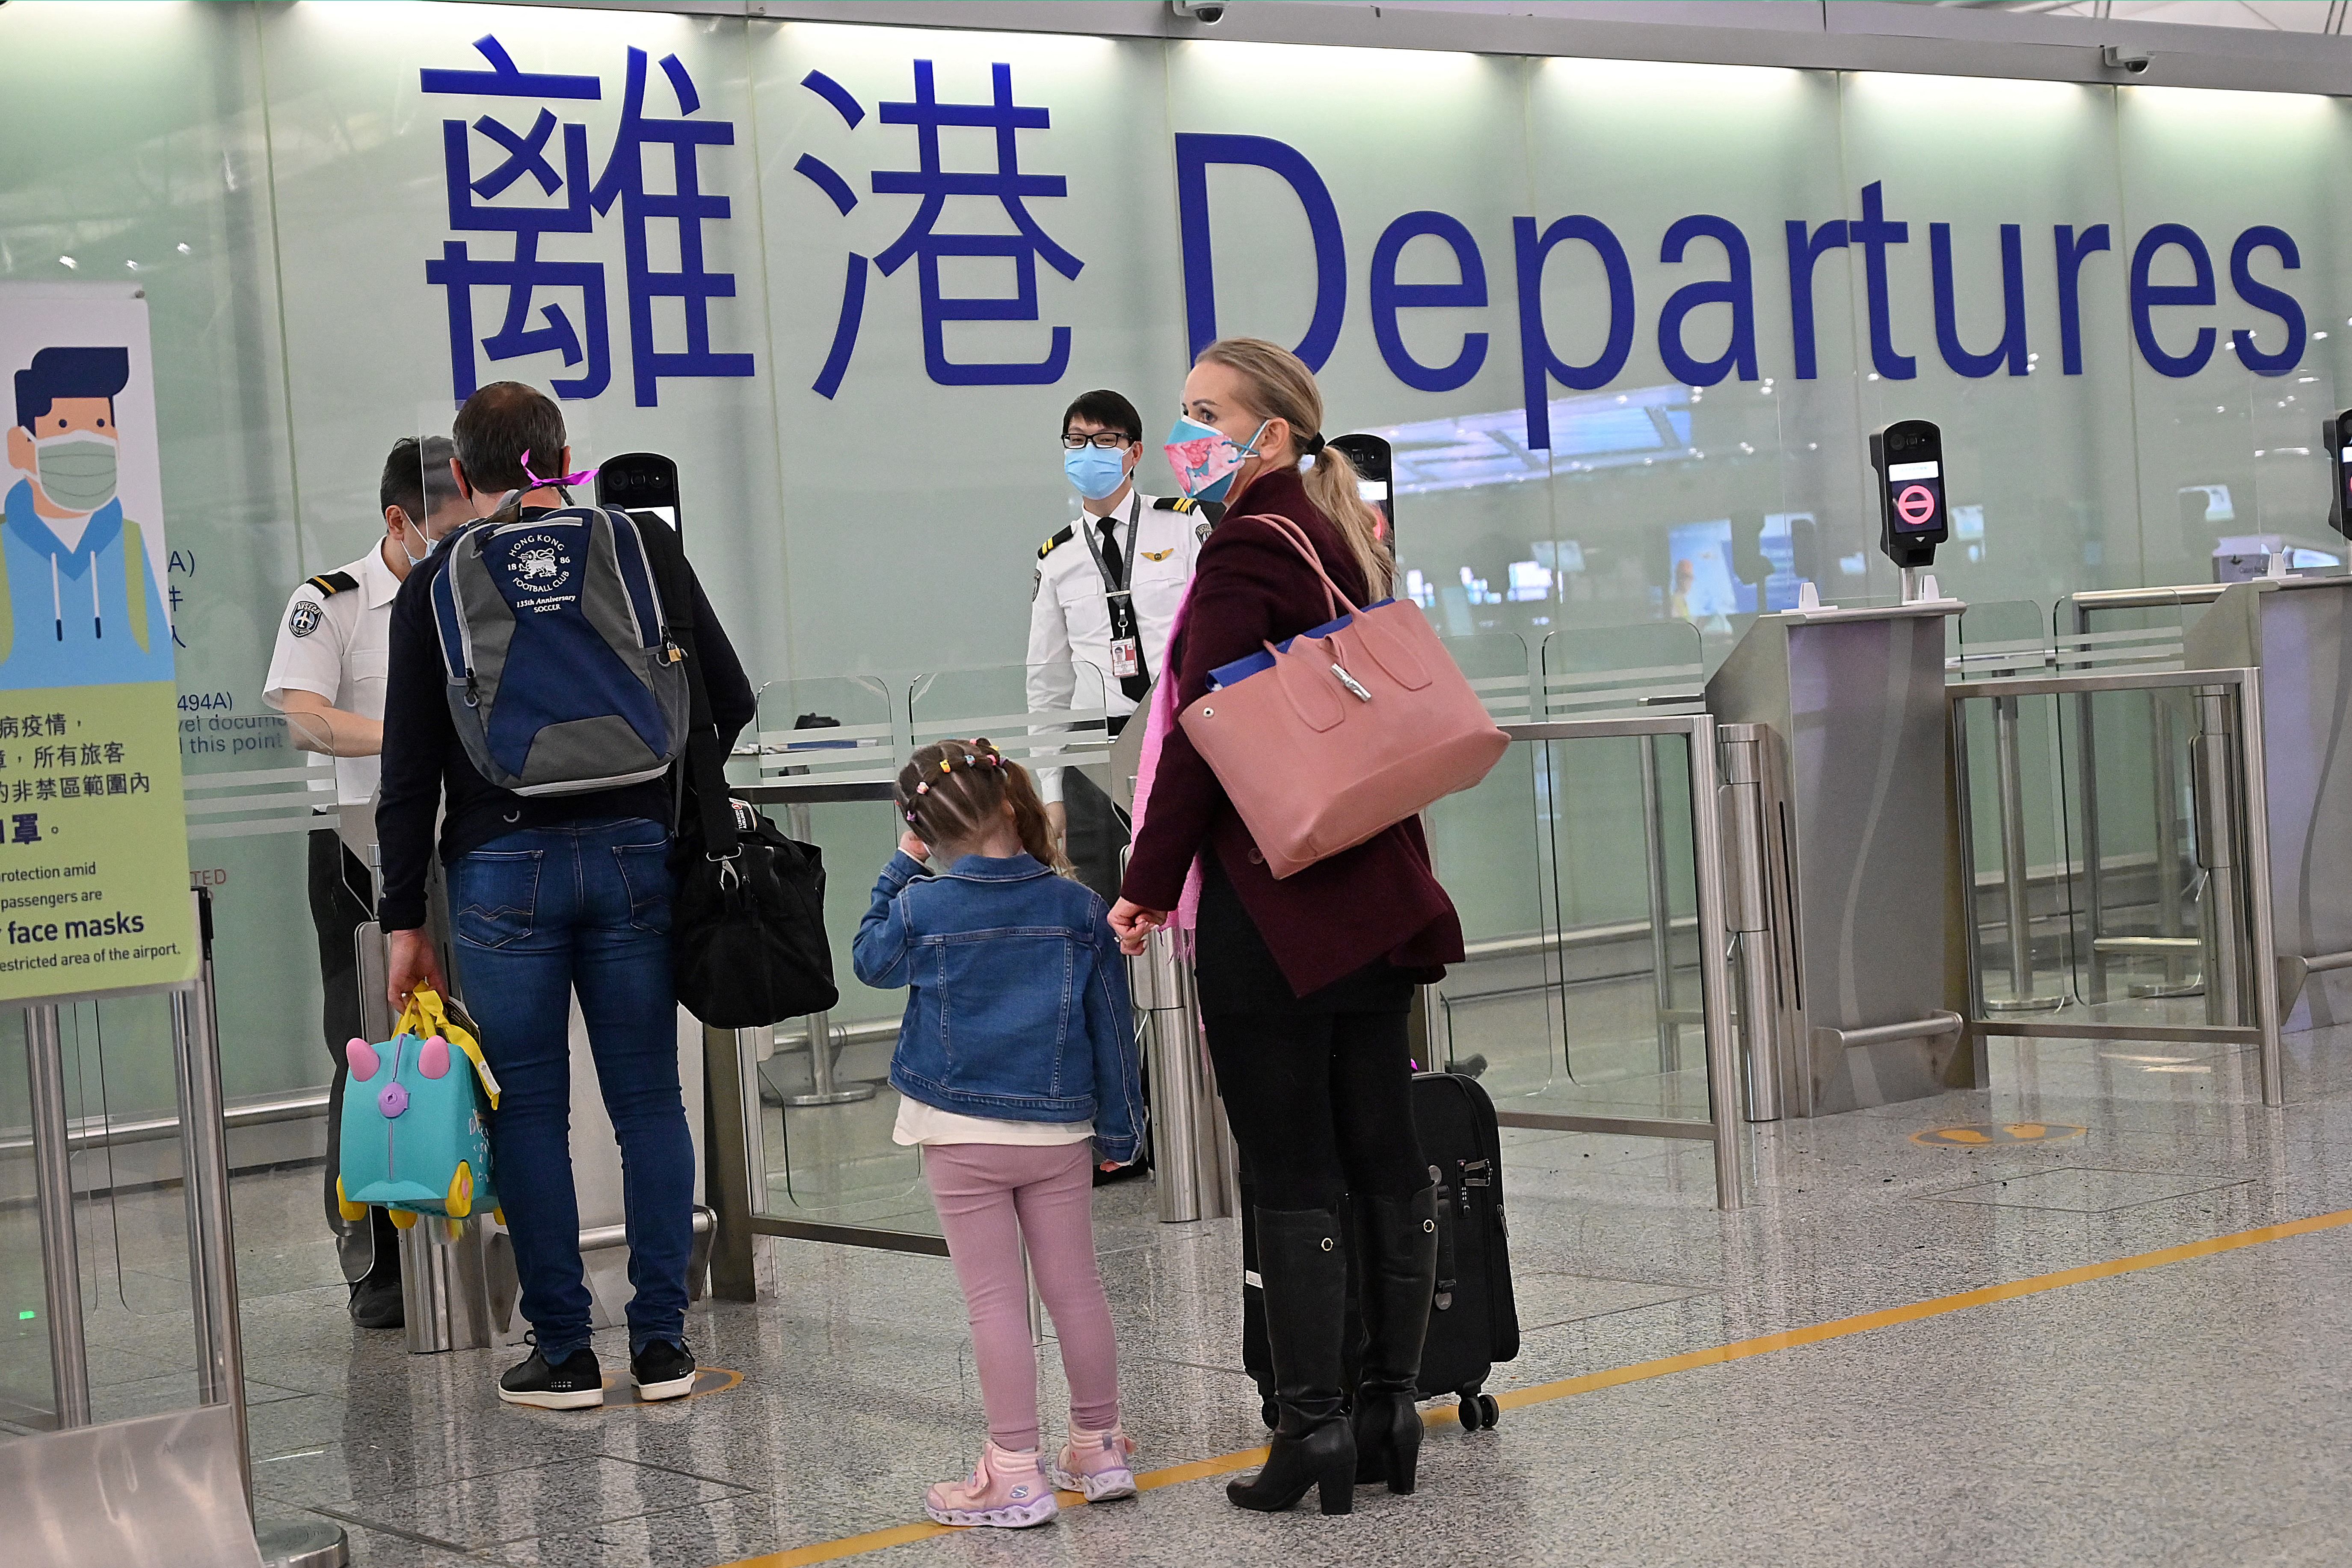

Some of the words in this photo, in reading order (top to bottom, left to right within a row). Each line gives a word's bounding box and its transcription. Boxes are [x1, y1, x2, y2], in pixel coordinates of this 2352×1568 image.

[420, 33, 1084, 409] 離港
[1173, 132, 2307, 450] Departures
[509, 535, 535, 556] HONG
[537, 534, 564, 551] KONG
[512, 577, 553, 592] FOOTBALL
[553, 571, 569, 587] CLUB
[297, 602, 320, 615] AVSECO
[516, 599, 535, 608] 135th
[536, 595, 576, 605] Anniversary
[533, 604, 561, 613] SOCCER
[177, 691, 233, 712] 494A)
[190, 735, 226, 754] this
[233, 732, 283, 755] point
[0, 813, 59, 845] 罩。
[0, 866, 60, 883] rotection
[63, 861, 96, 877] amid
[1, 892, 78, 912] passengers
[81, 890, 103, 902] are
[8, 920, 58, 945] face
[65, 911, 145, 940] masks
[61, 953, 90, 966] area
[93, 948, 106, 963] of
[109, 947, 130, 961] the
[133, 942, 181, 961] airport.
